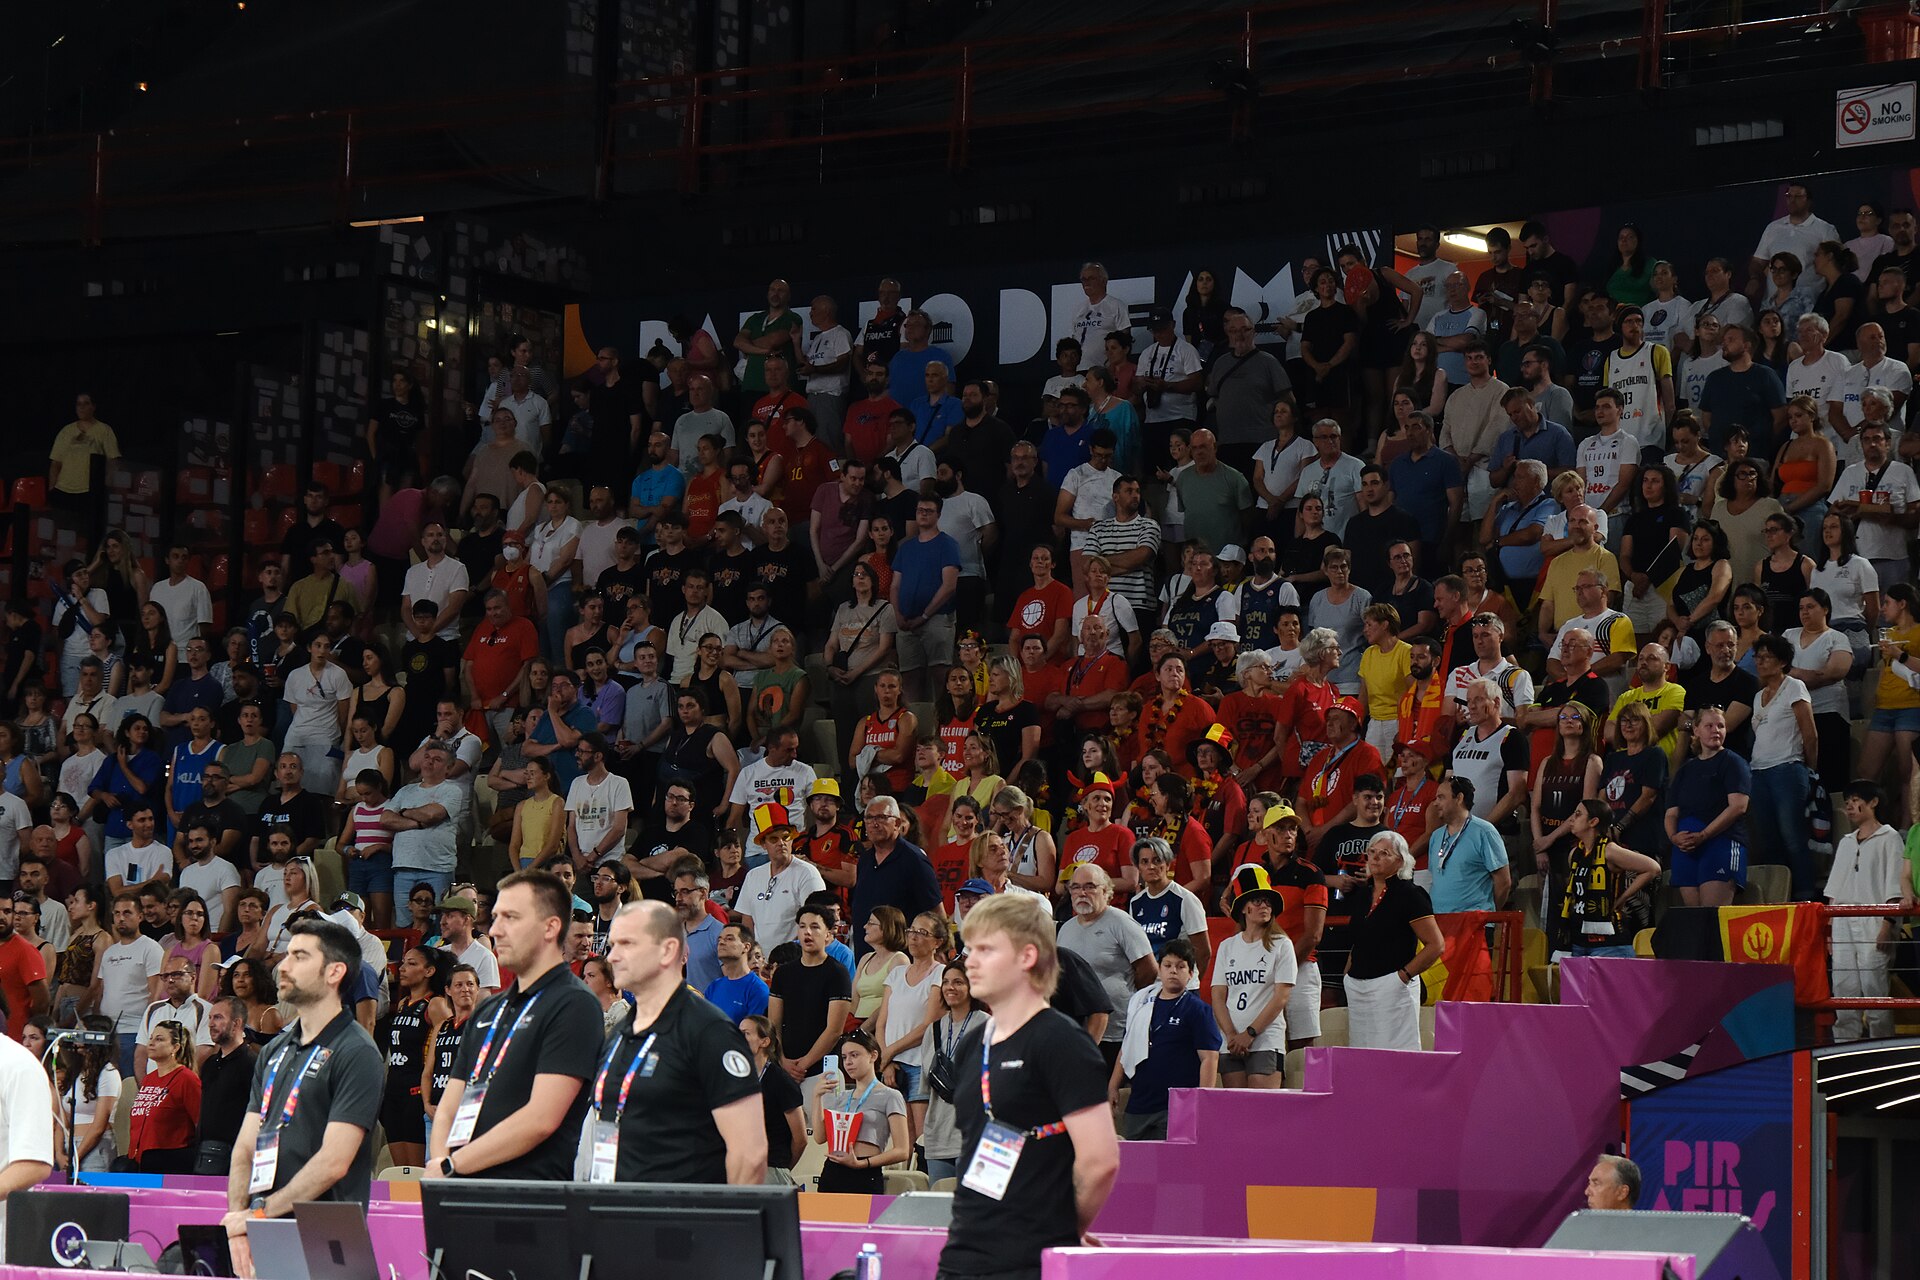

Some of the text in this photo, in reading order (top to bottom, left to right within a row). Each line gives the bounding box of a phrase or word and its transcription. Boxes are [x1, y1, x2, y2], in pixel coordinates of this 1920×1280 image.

[1881, 101, 1902, 116] NO
[1872, 113, 1911, 126] SMOKING
[866, 331, 894, 341] FRANCE
[1623, 391, 1633, 406] 13
[1691, 385, 1701, 402] 3
[1594, 466, 1605, 478] 99
[1176, 623, 1194, 637] 47
[1246, 625, 1261, 640] 35
[866, 731, 895, 744] BELGIUM
[940, 727, 969, 737] BELGIUM
[1455, 749, 1490, 760] BELGIUM
[755, 778, 795, 788] BELGIUM
[1553, 791, 1563, 808] 11
[1225, 969, 1267, 986] FRANCE
[1237, 992, 1248, 1011] 6
[391, 1030, 400, 1046] 31
[442, 1051, 452, 1067] 31
[131, 1107, 146, 1117] CAN
[1664, 1140, 1742, 1187] PIR
